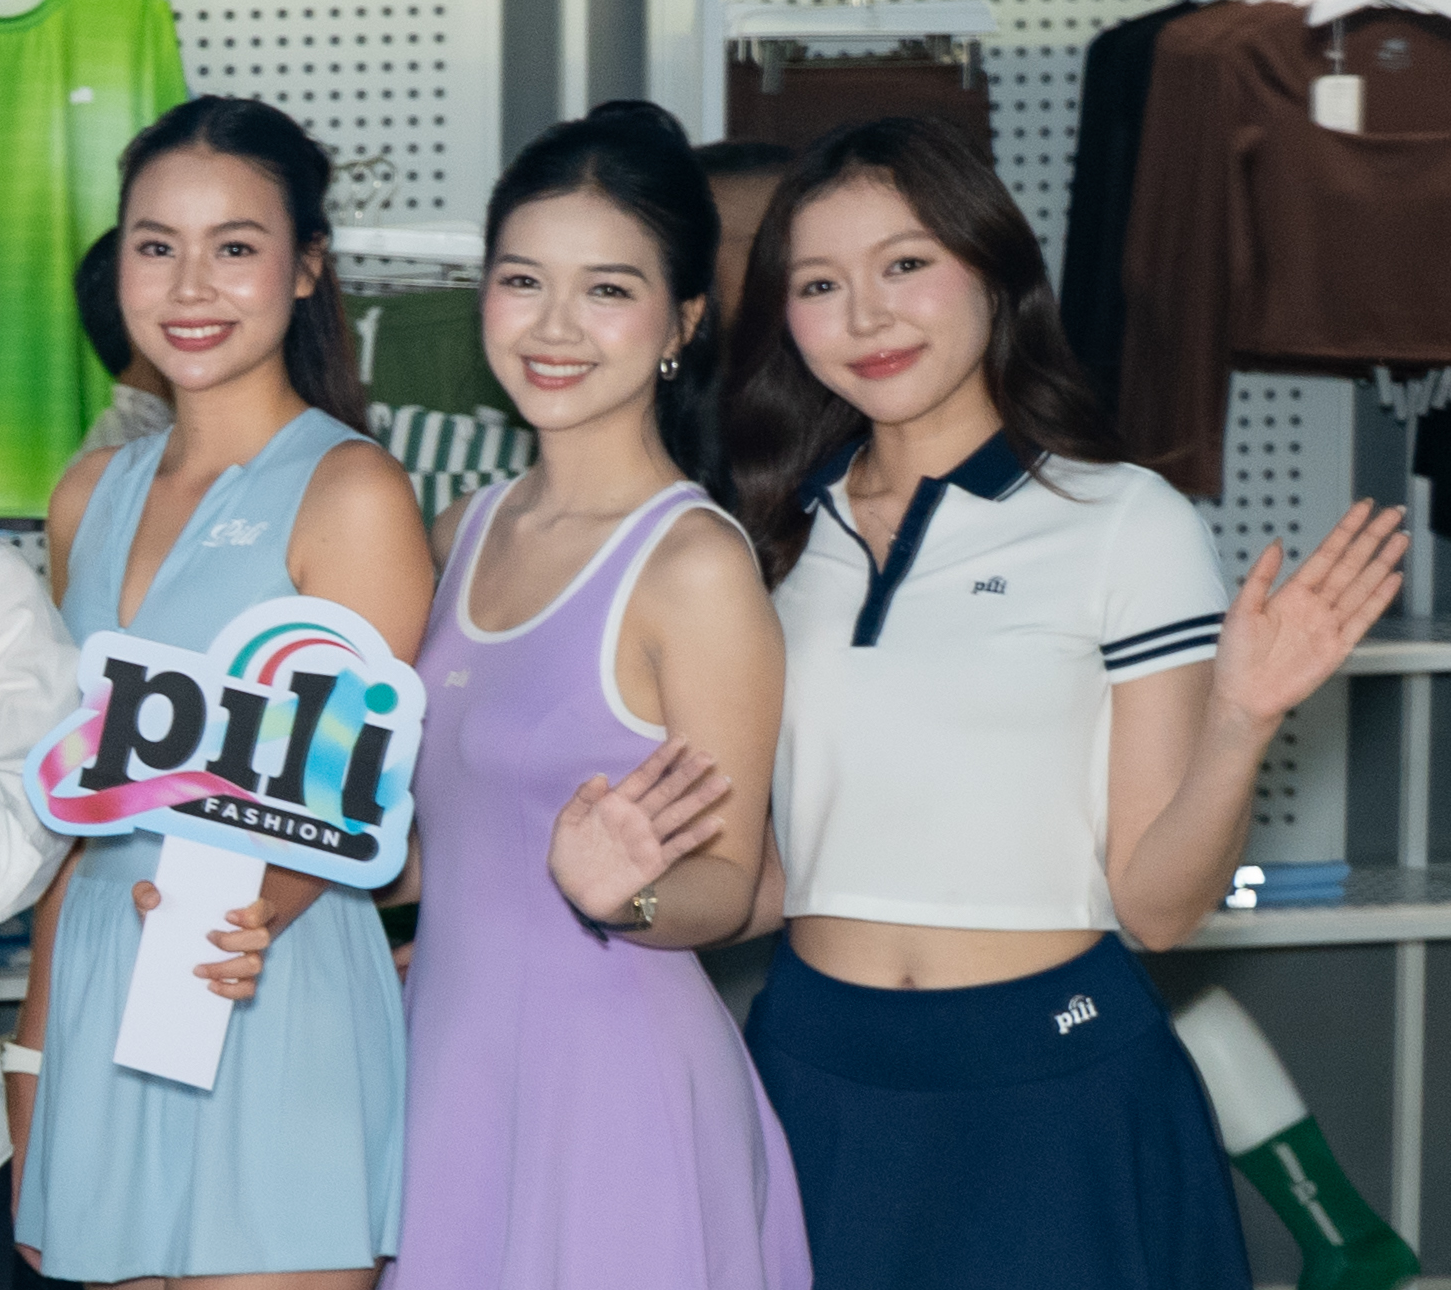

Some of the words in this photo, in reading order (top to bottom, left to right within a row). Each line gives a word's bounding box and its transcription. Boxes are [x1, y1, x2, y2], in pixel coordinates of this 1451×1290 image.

[79, 656, 399, 827] pili
[203, 796, 342, 848] FASHION
[1054, 996, 1099, 1036] pili
